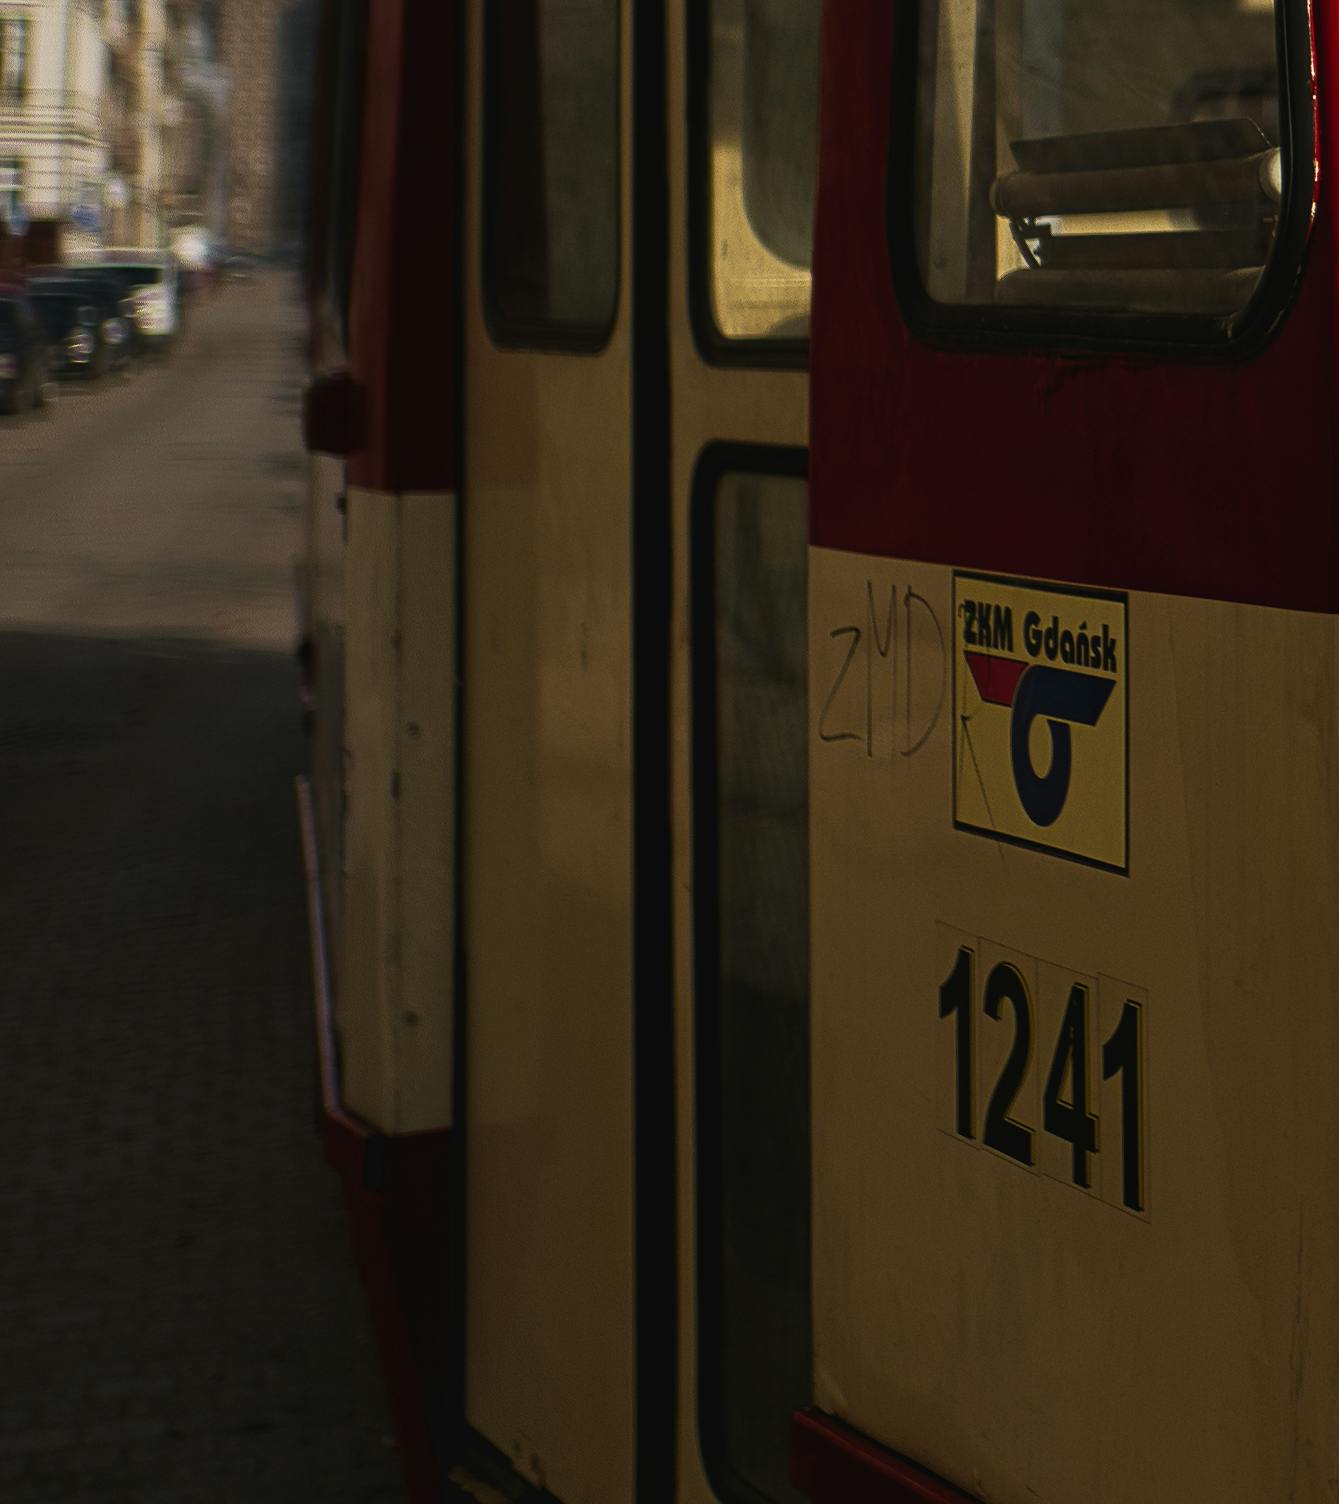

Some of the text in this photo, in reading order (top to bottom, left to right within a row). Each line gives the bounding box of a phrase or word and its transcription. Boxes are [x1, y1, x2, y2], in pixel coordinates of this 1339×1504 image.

[961, 598, 1119, 674] ZKM Gdańsk
[938, 944, 1145, 1213] 1241
